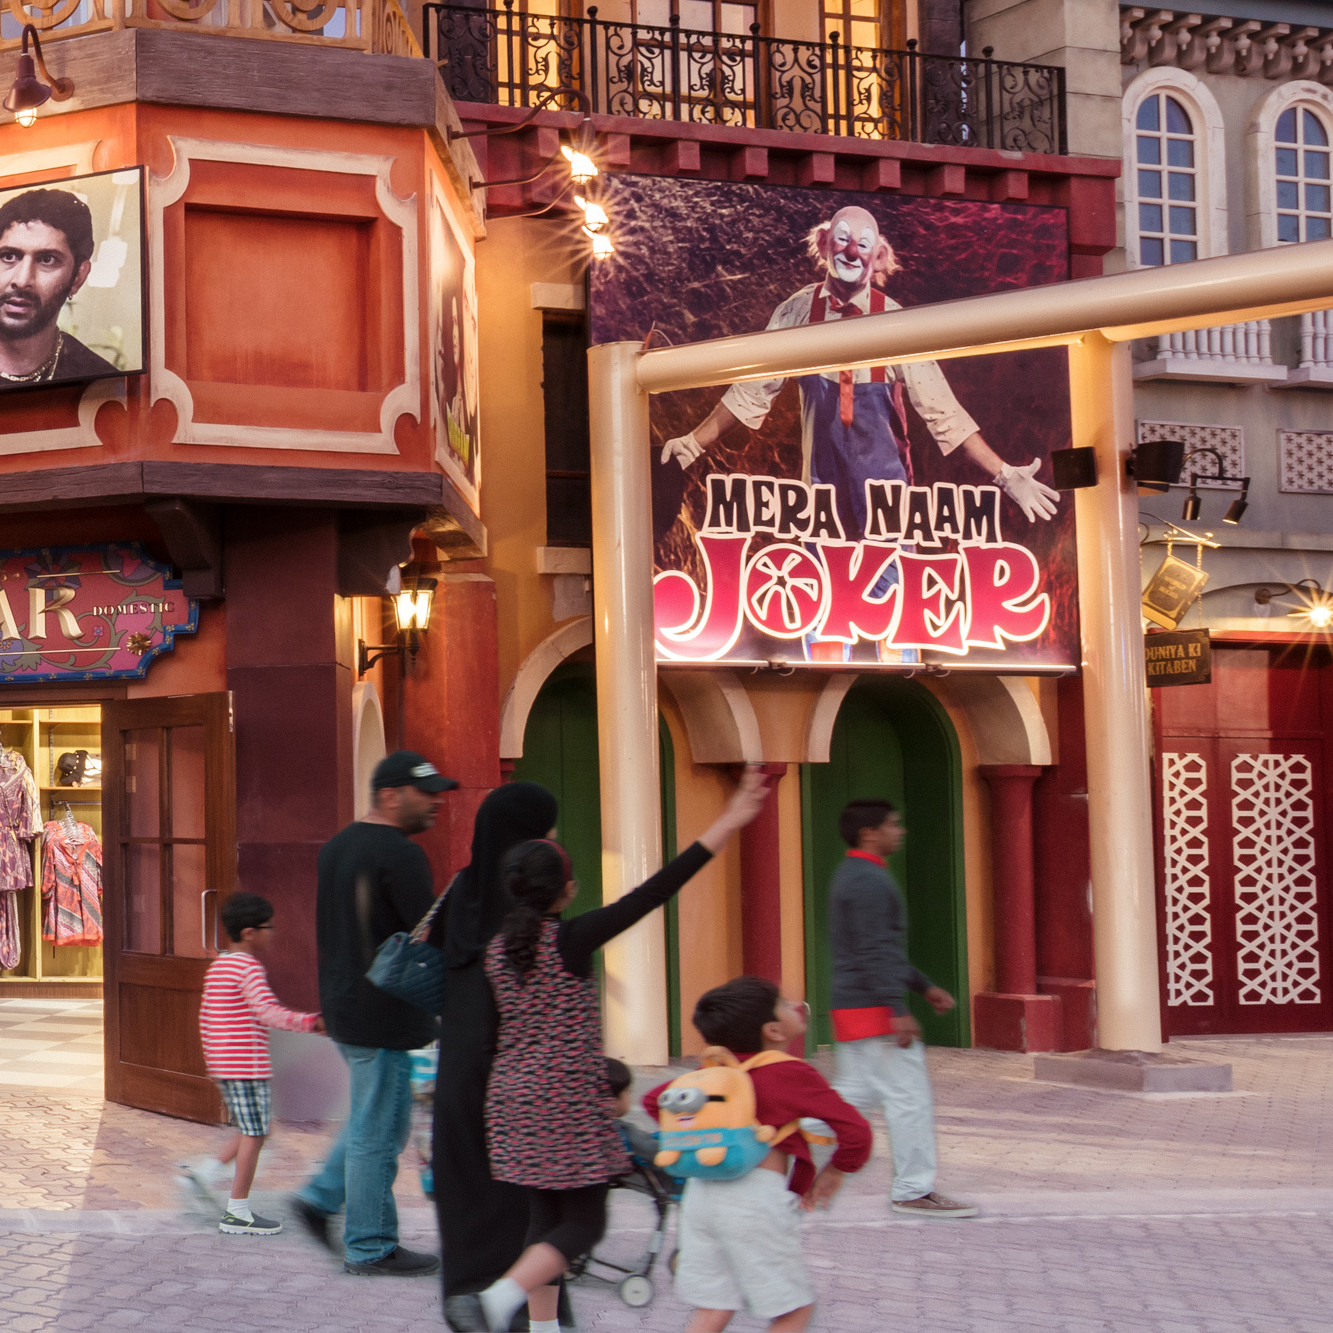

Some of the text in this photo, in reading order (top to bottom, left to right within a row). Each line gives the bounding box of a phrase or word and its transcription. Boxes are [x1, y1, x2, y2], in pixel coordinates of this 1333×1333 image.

[703, 474, 1003, 547] MERA NAAM
[654, 533, 1051, 661] JOKER
[93, 601, 175, 616] DOMESTIC
[1188, 642, 1202, 657] KI
[1148, 658, 1196, 675] KITABEN
